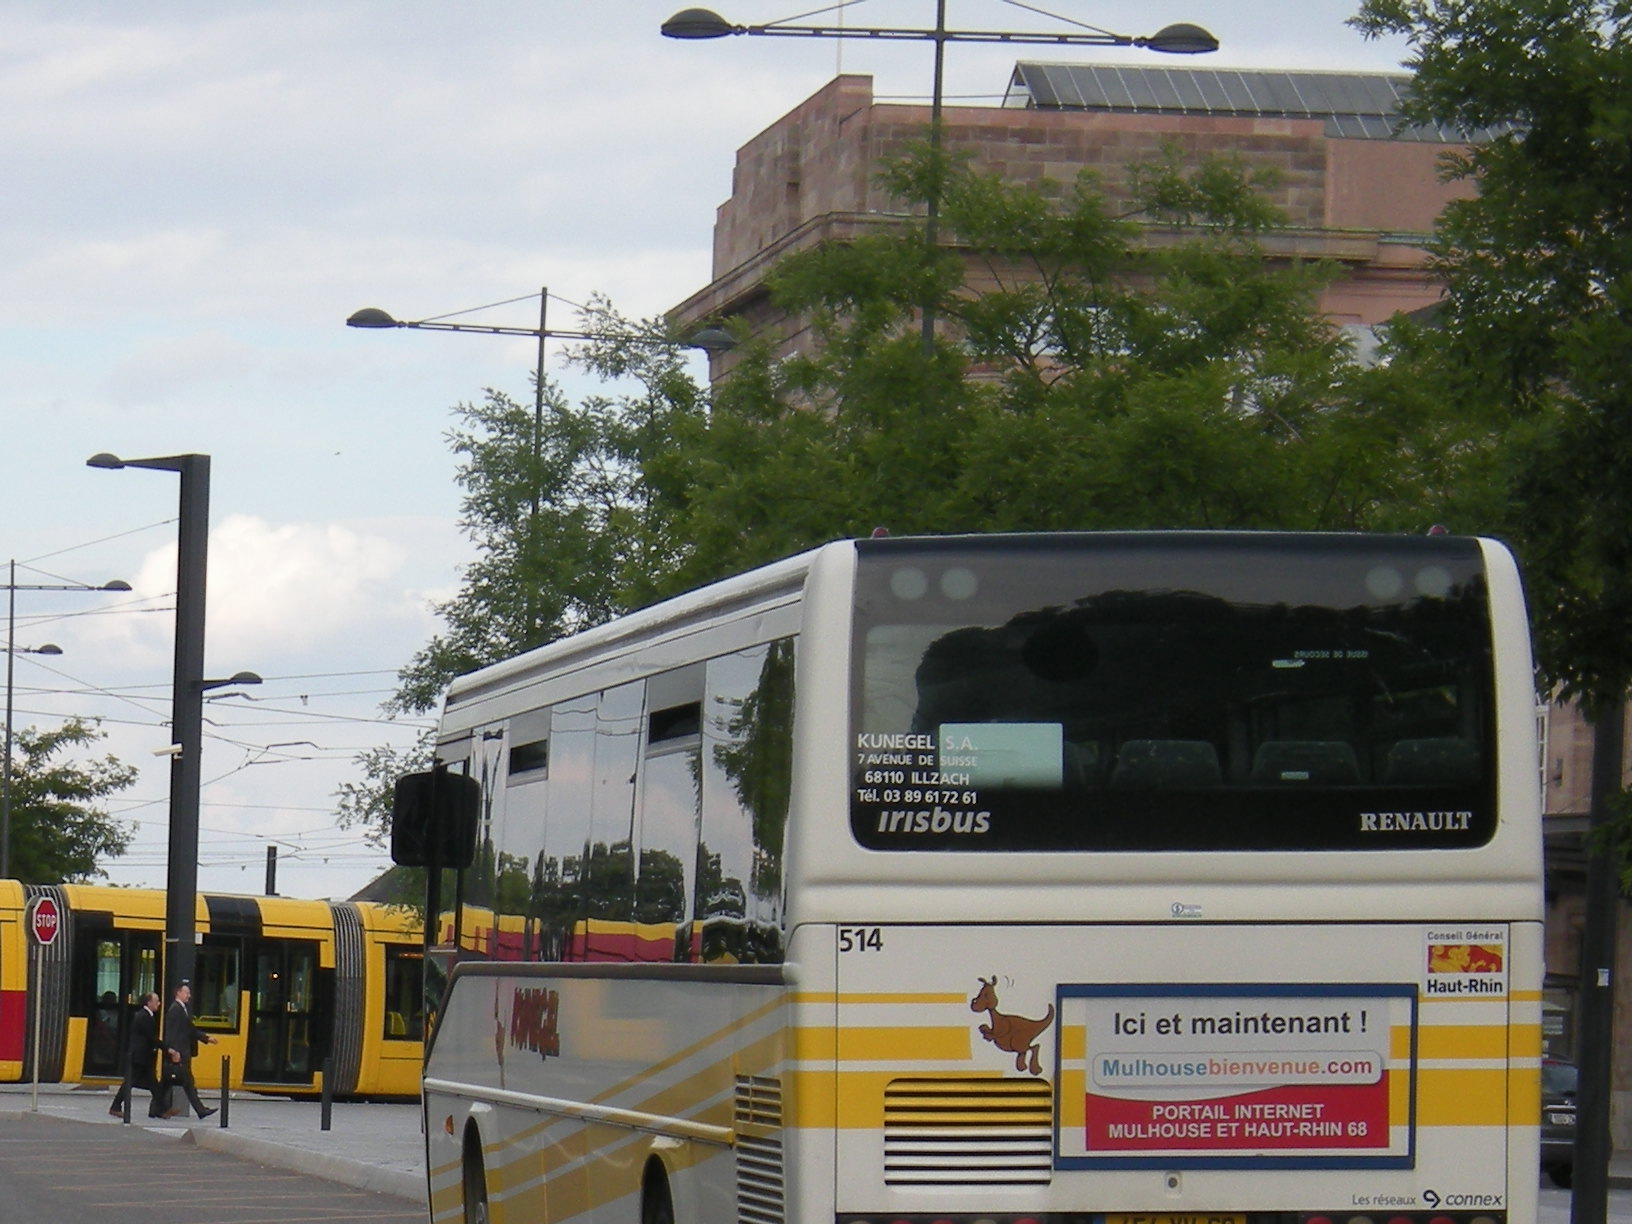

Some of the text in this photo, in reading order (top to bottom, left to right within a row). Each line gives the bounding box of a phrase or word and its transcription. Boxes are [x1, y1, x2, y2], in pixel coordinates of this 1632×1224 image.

[857, 733, 978, 750] KUNEGEL S.A.
[857, 753, 978, 767] 7 AVENUE DE SUISSE
[864, 770, 969, 785] 68110 ILLZACH
[857, 788, 977, 804] Tél. 03 89 61 72 61
[877, 806, 990, 833] irisbus
[1360, 811, 1472, 831] RENAULT
[36, 913, 57, 928] STOP
[839, 927, 884, 952] 514
[1427, 930, 1504, 940] Conseil Général
[1427, 979, 1504, 993] Haut-Rhin
[1114, 1011, 1367, 1035] Ici et maintenant !
[1102, 1059, 1373, 1077] Mulhousebienvenue.com
[1152, 1104, 1324, 1120] PORTAIL INTERNET
[1108, 1121, 1367, 1138] MULHOUSE ET HAUT-RHIN 68
[1352, 1194, 1416, 1206] Les réseaux
[1445, 1194, 1502, 1206] connex
